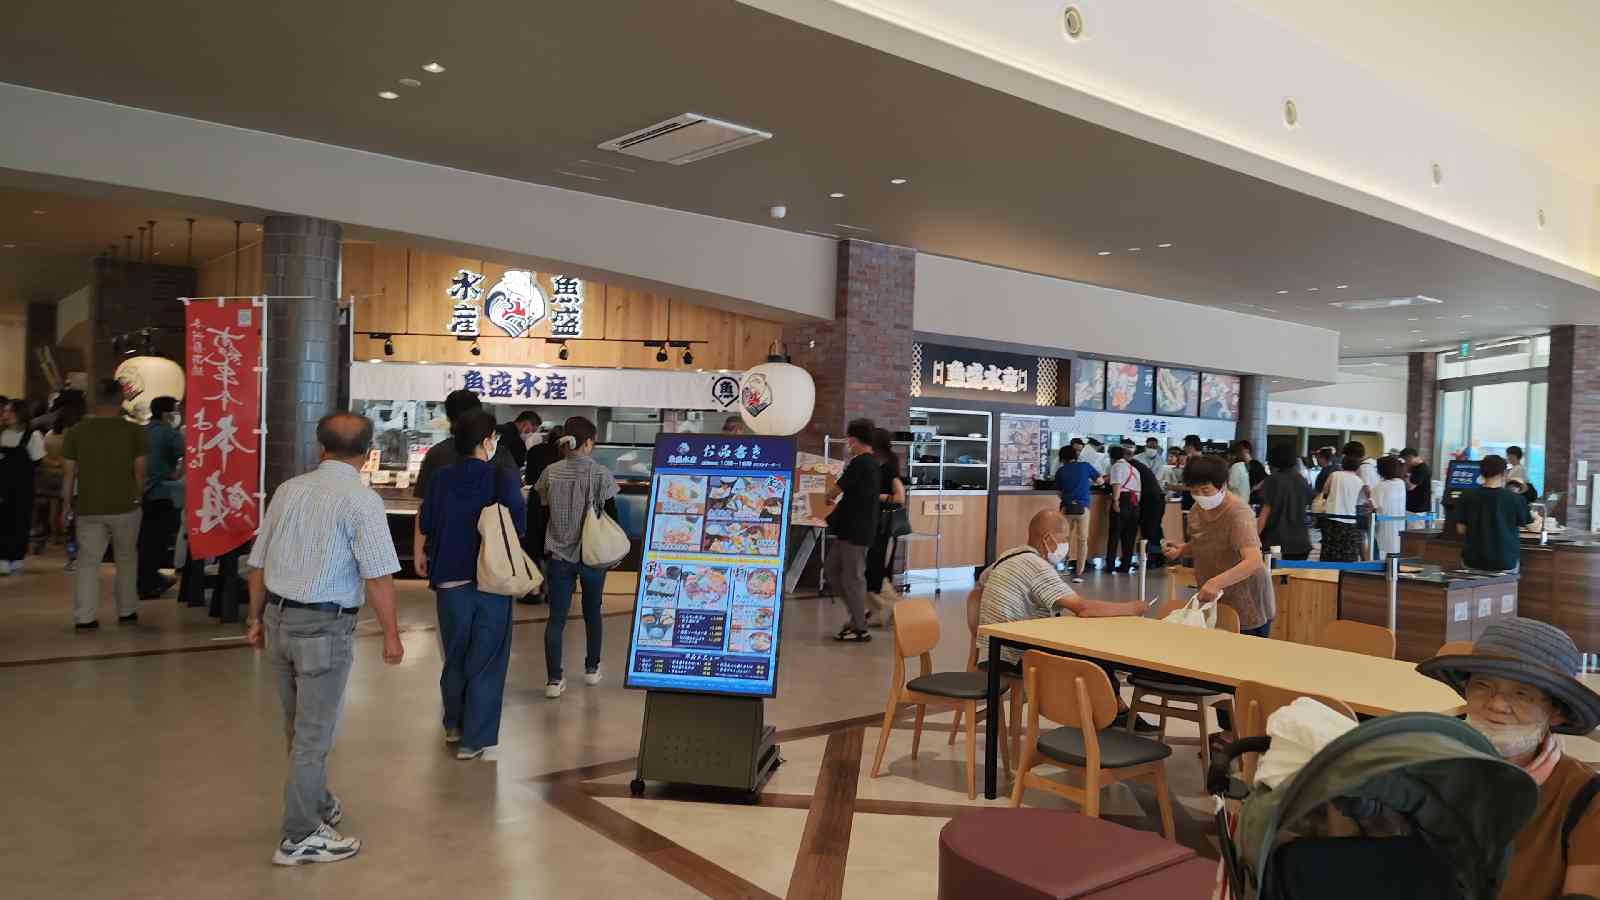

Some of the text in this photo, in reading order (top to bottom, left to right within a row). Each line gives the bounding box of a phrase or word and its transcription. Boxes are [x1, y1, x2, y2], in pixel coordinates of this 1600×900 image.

[449, 271, 482, 336] 水産
[551, 276, 583, 338] 魚盛
[463, 369, 568, 401] 魚盛水産
